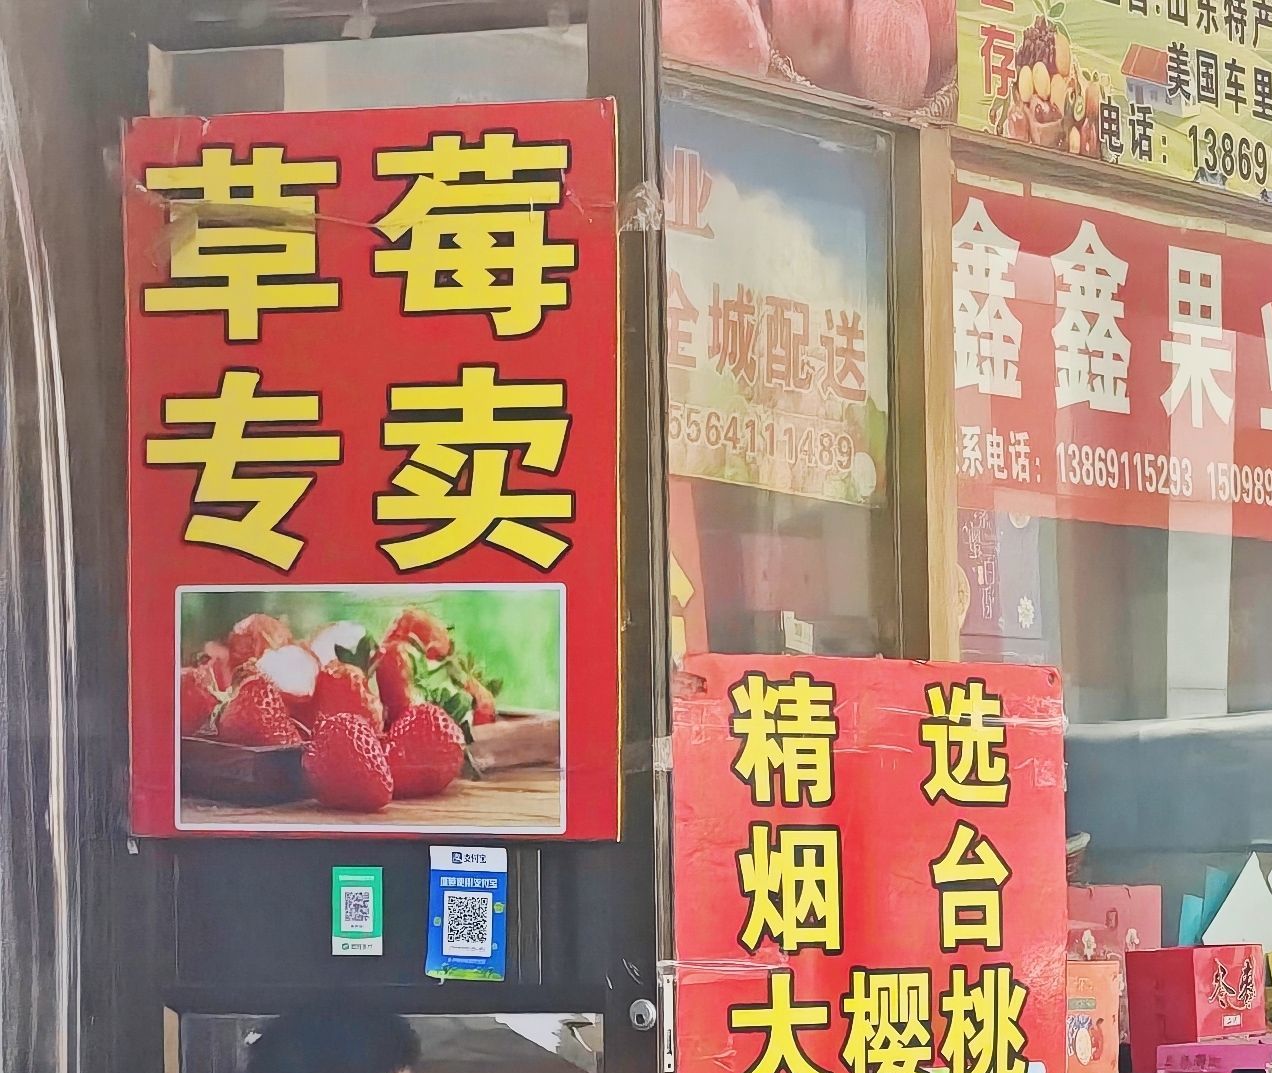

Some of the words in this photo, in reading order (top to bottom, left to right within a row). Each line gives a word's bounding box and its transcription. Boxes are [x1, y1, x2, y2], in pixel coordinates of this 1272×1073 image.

[143, 131, 575, 341] 草莓
[667, 271, 868, 404] 全城配送
[145, 361, 573, 572] 专卖
[953, 425, 1042, 486] 系电话:
[1056, 441, 1194, 498] 13869115293
[729, 670, 1011, 807] 精选
[735, 819, 1013, 956] 烟台
